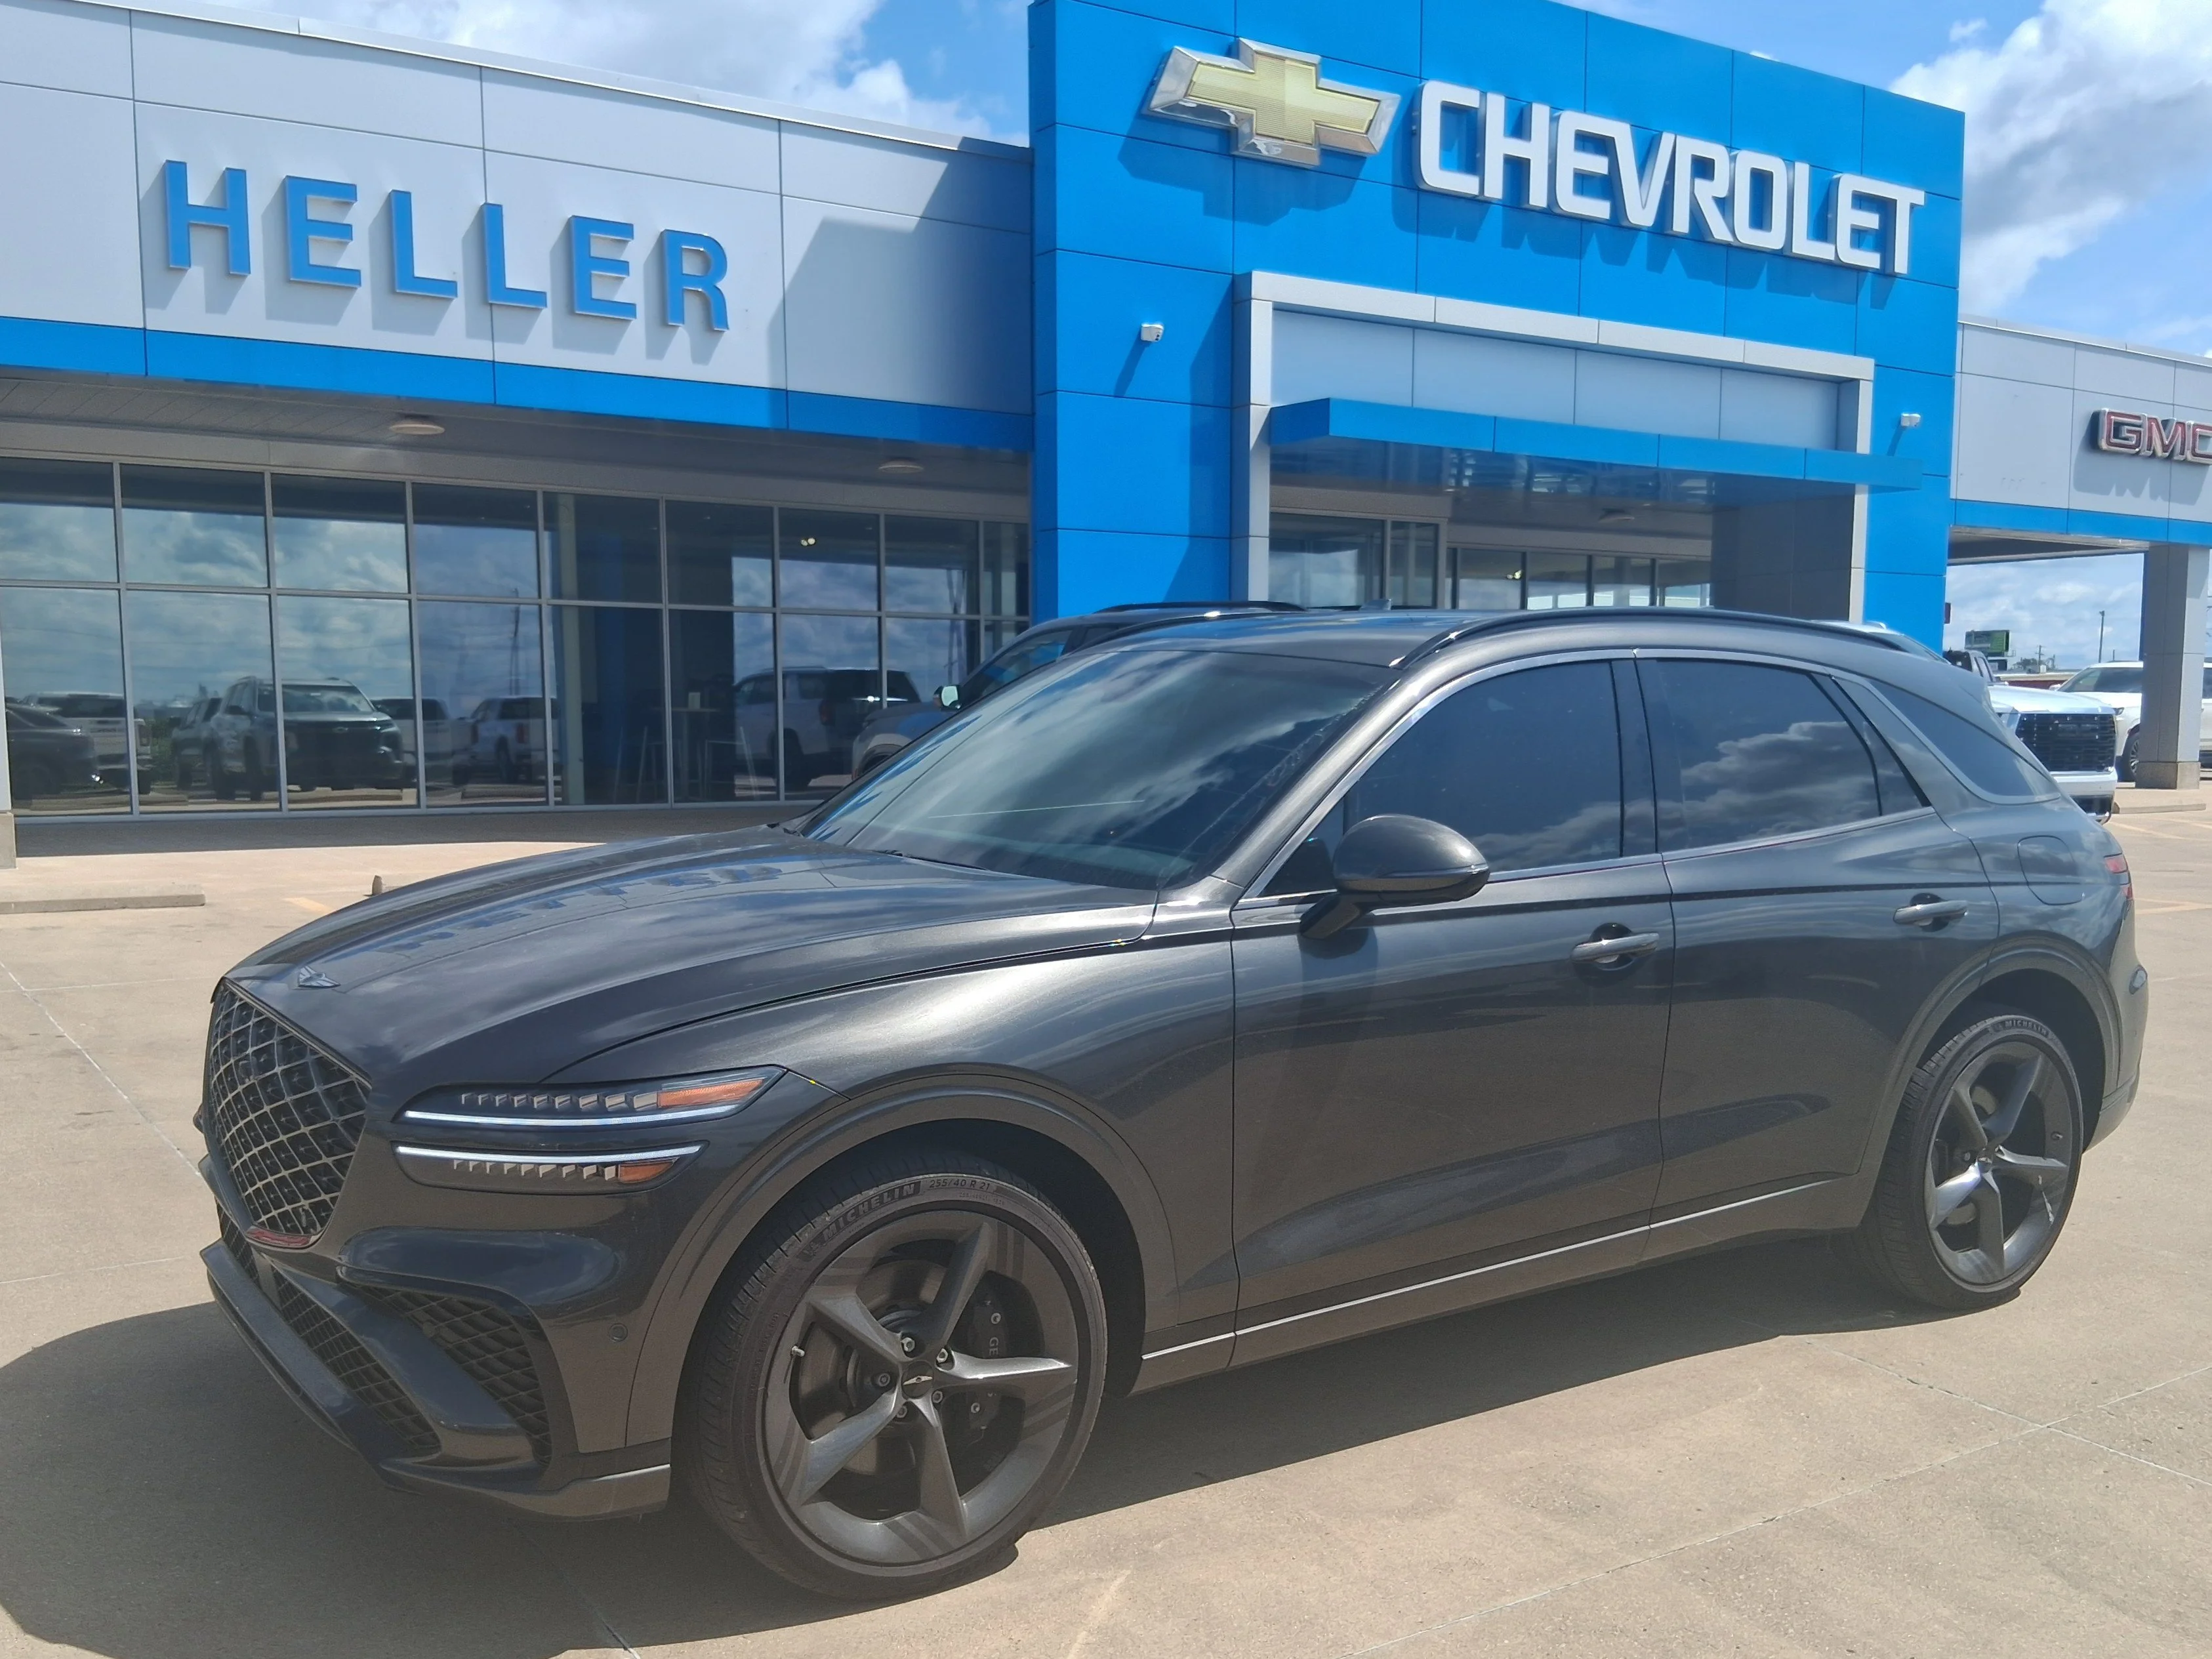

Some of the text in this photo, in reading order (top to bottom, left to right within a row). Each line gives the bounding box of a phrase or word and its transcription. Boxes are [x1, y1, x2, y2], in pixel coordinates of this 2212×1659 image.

[1413, 80, 1925, 275] CHEVROLET
[164, 159, 729, 331] HELLER
[2098, 407, 2212, 465] GMC
[823, 1182, 916, 1241] MICHELIN
[929, 1179, 967, 1189] 255/40
[970, 1180, 976, 1189] R
[979, 1181, 991, 1191] 21
